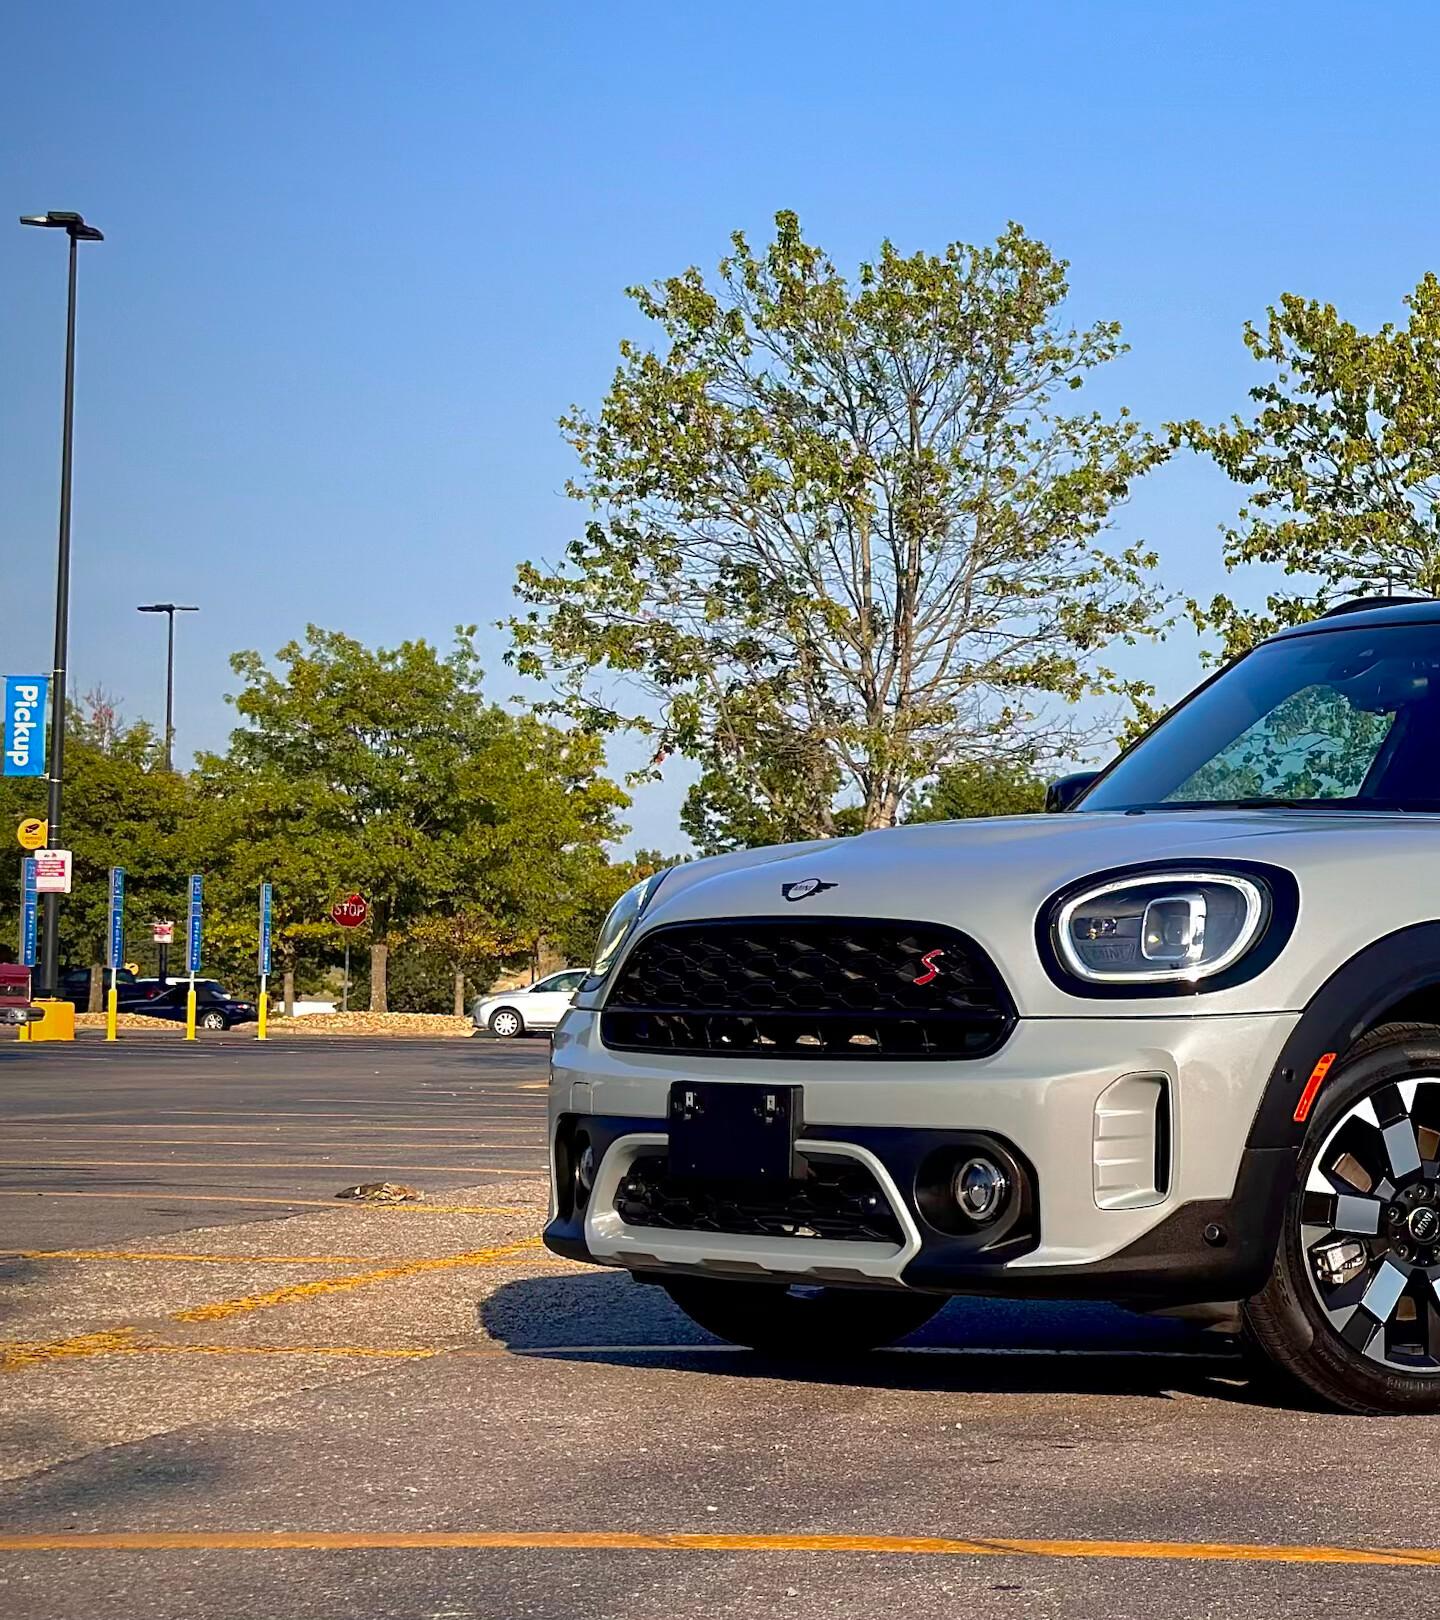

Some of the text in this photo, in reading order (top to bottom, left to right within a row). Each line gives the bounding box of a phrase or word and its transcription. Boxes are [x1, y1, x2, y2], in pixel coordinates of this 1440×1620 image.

[7, 685, 39, 767] Pickup
[334, 903, 365, 917] STOP
[913, 949, 944, 986] S
[1414, 1211, 1433, 1236] MINI
